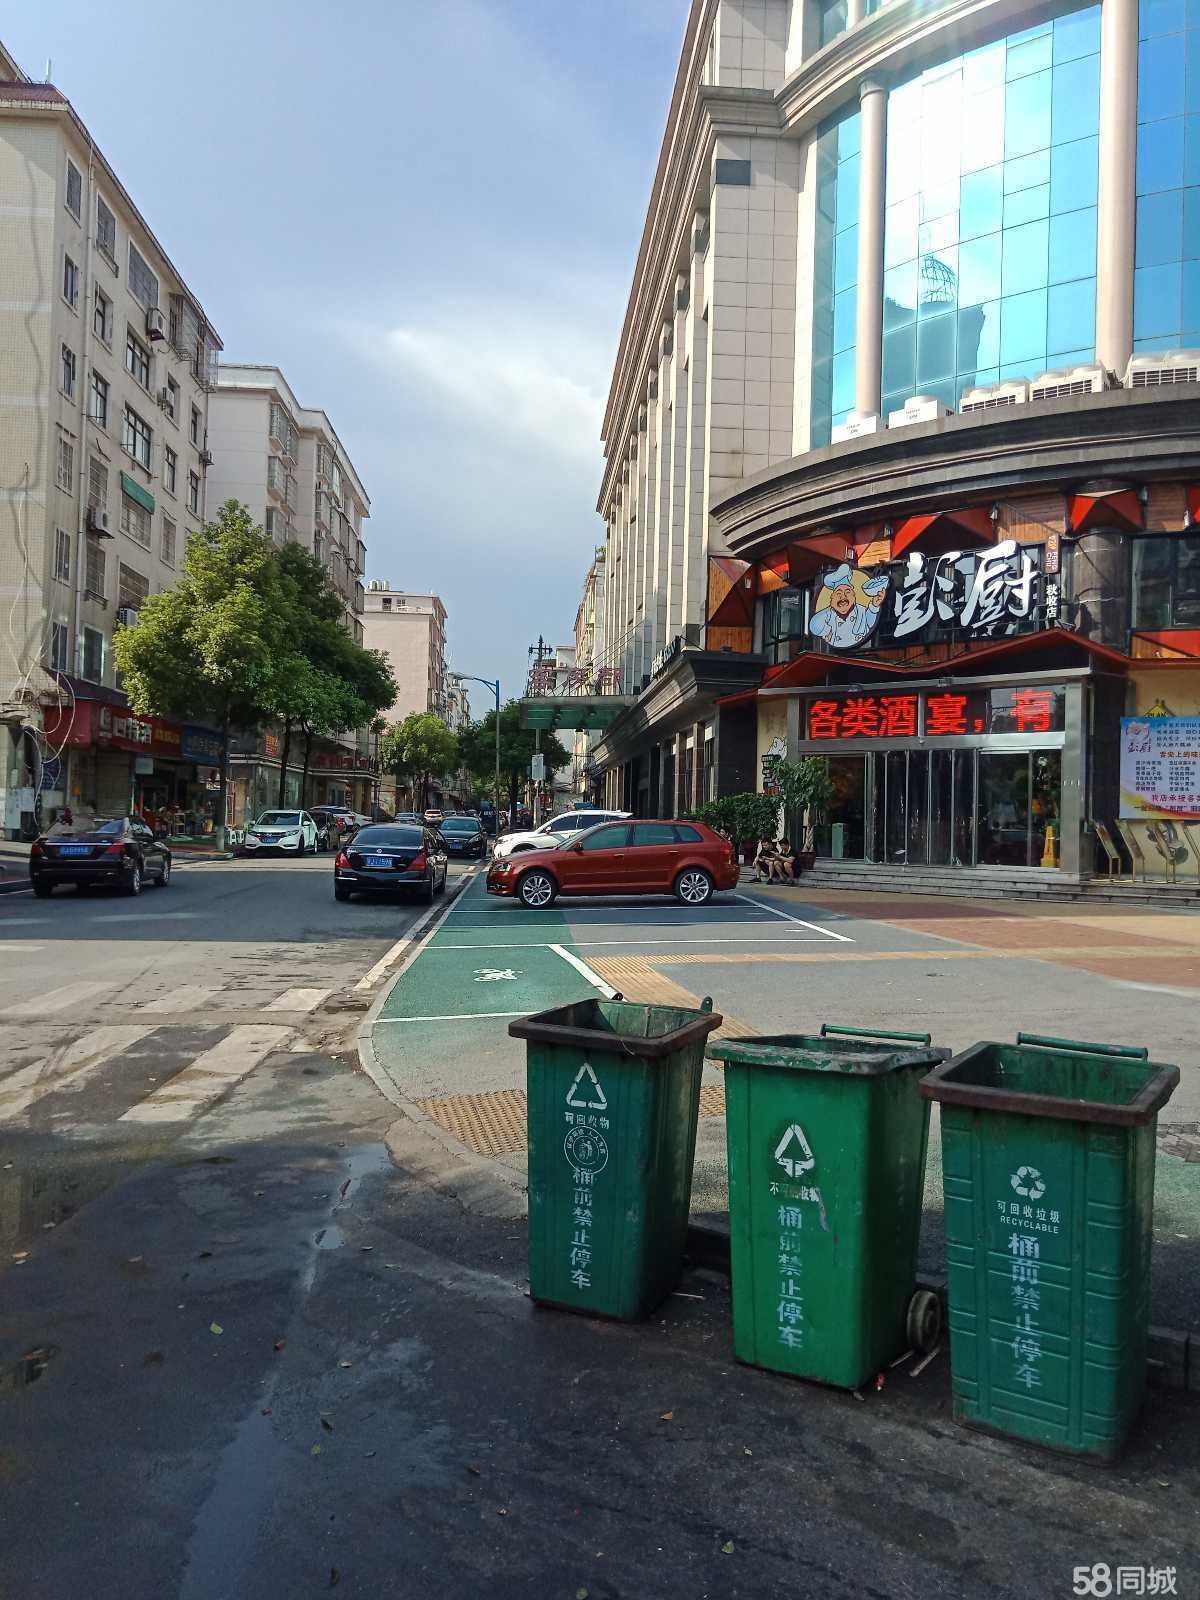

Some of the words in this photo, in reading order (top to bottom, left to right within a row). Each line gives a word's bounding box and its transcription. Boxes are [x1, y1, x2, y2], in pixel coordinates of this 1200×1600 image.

[893, 540, 1043, 637] 彭厨
[1045, 584, 1058, 618] 秋收店
[570, 1166, 593, 1289] 桶前禁止停车
[996, 1200, 1061, 1224] 可回收垃圾
[1000, 1215, 1059, 1234] RECYCLABLE
[777, 1204, 804, 1348] 桶前禁止停车
[1008, 1232, 1042, 1389] 桶前禁止停车
